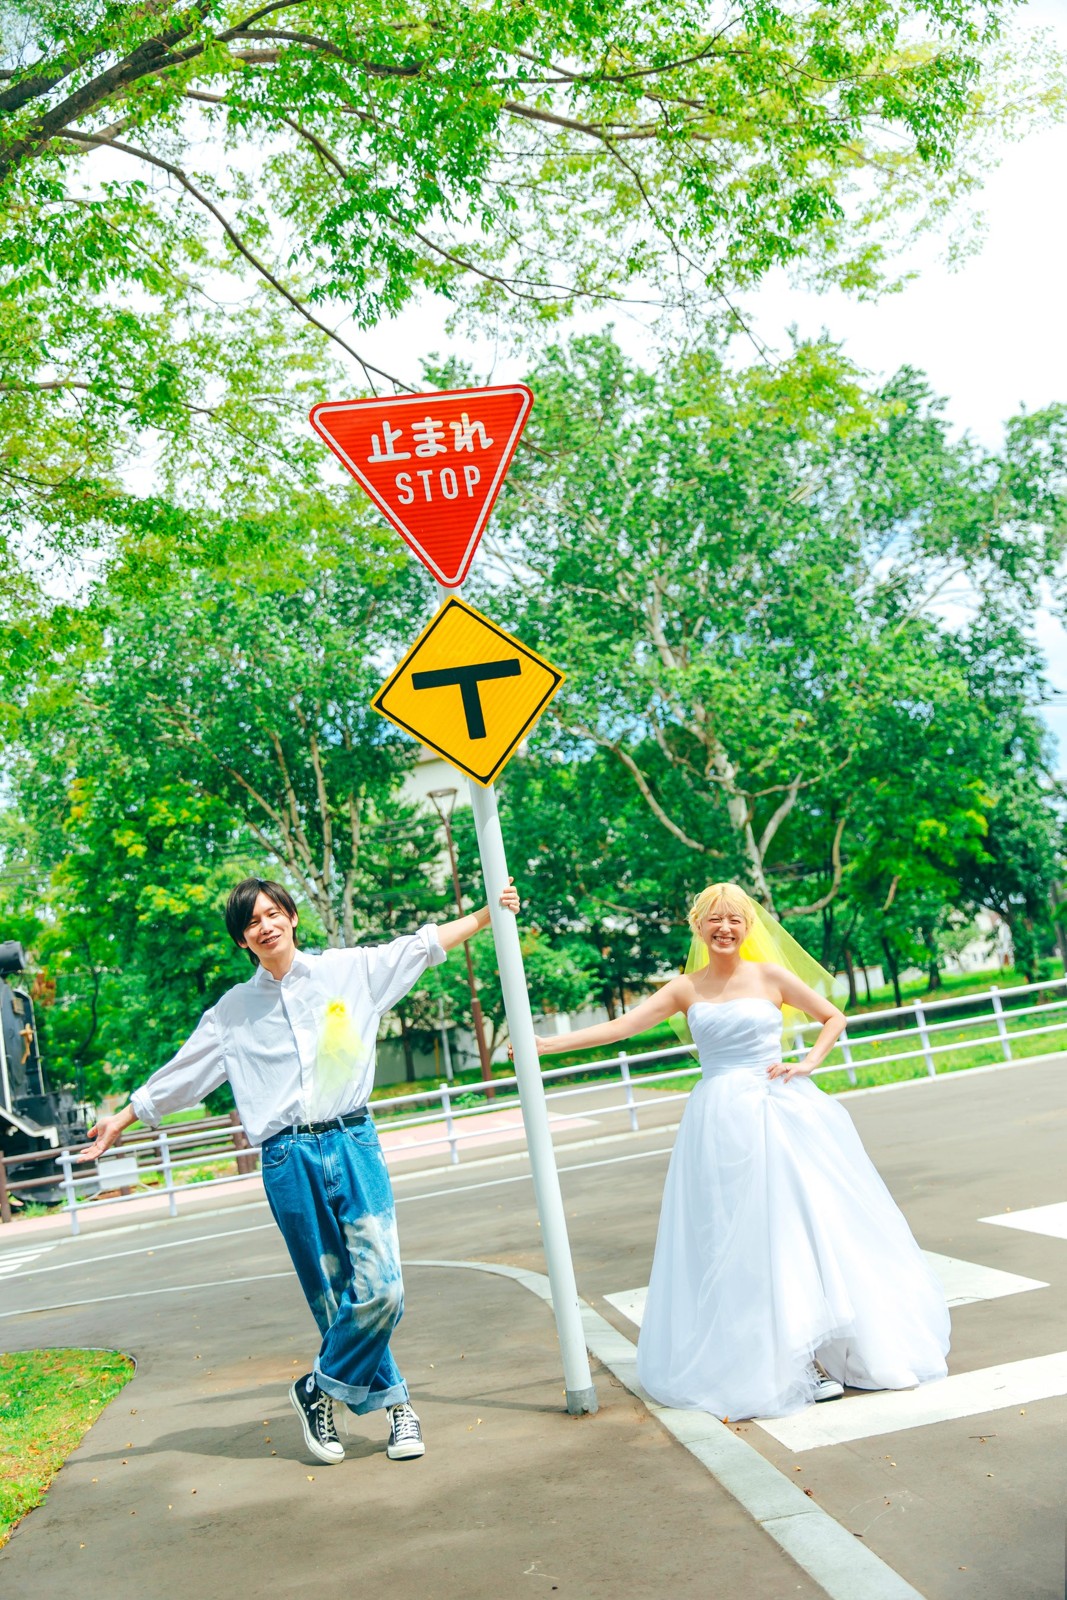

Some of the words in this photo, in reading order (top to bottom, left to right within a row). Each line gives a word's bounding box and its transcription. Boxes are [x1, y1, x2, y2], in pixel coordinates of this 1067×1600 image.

[367, 413, 494, 463] 止まれ
[395, 466, 481, 505] STOP
